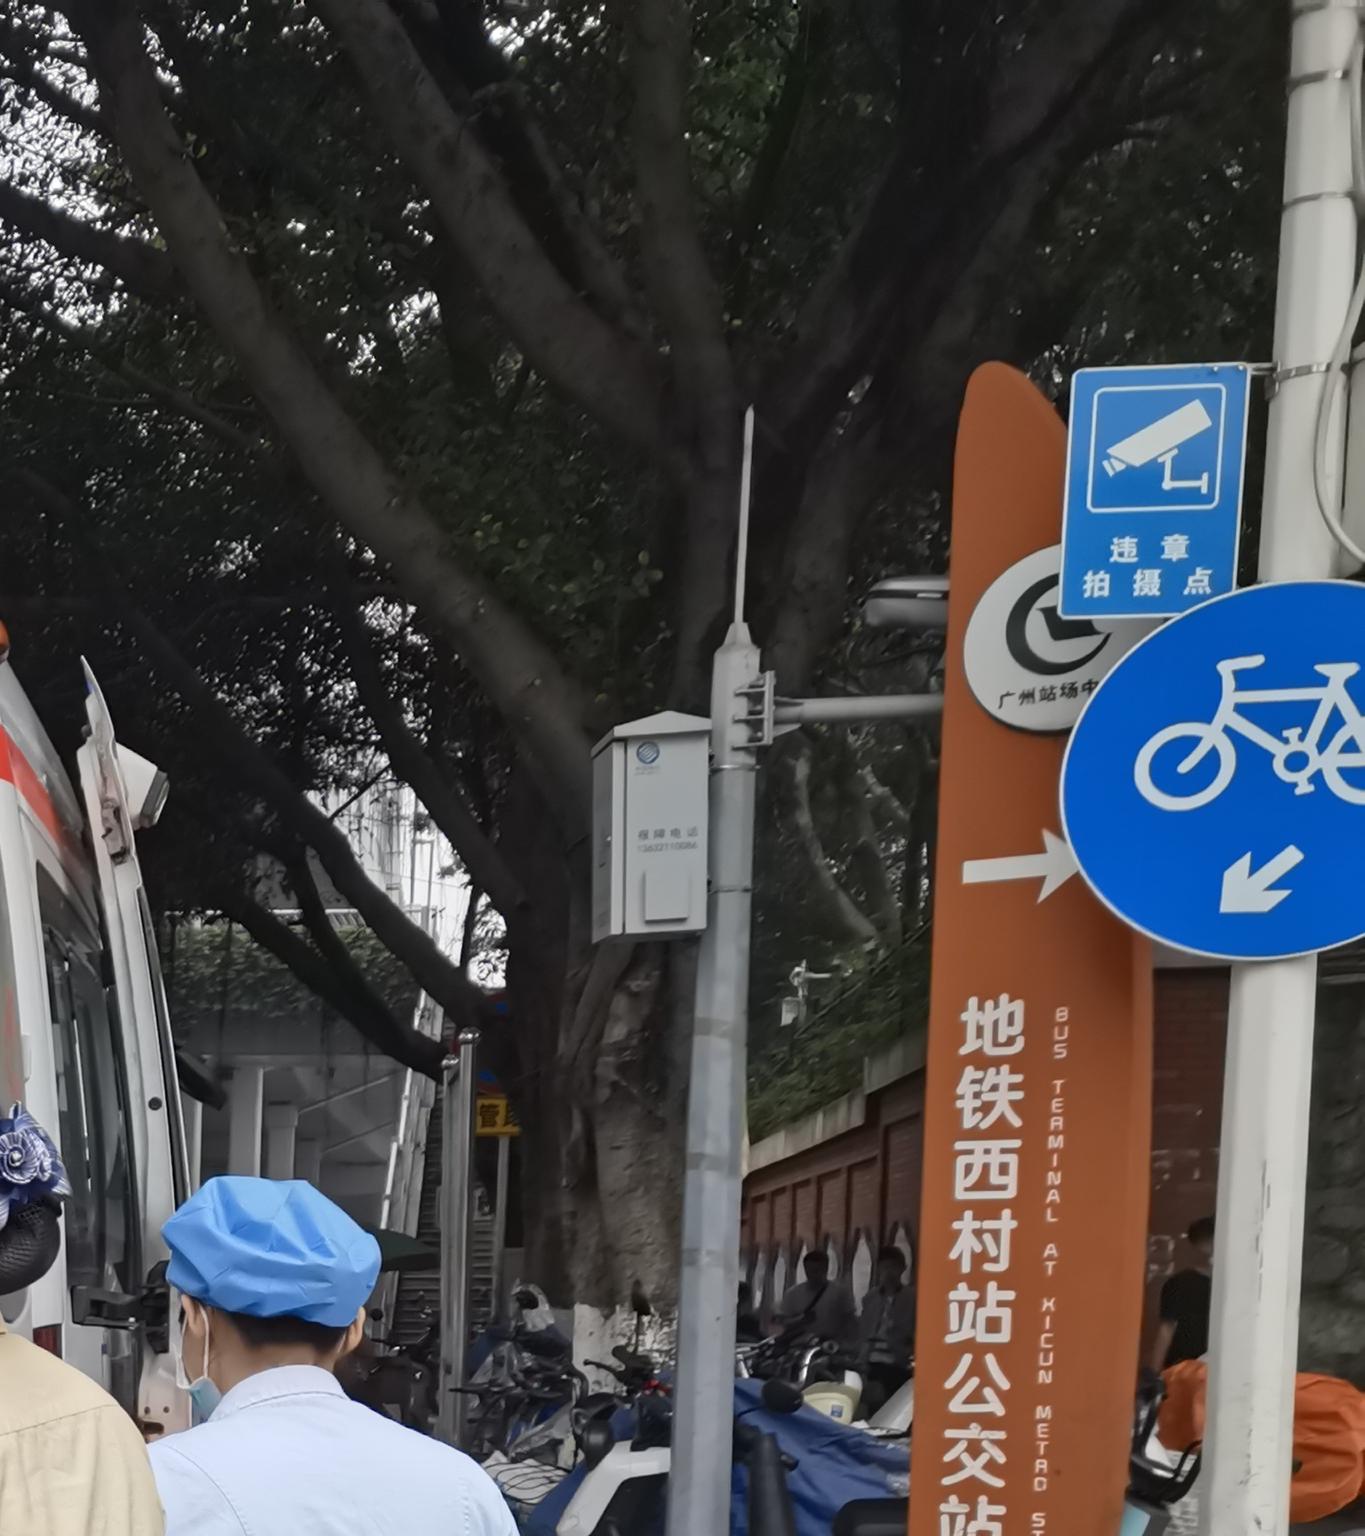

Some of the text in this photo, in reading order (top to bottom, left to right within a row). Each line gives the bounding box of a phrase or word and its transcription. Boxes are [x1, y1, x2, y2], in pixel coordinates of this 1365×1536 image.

[1109, 533, 1190, 563] 违章
[1082, 566, 1213, 598] 拍摄点
[1053, 1006, 1069, 1060] BUS
[1045, 1079, 1067, 1223] TERMINAL
[1042, 1242, 1059, 1276] AT
[1037, 1297, 1056, 1385] XICUN
[1033, 1404, 1052, 1492] METRO
